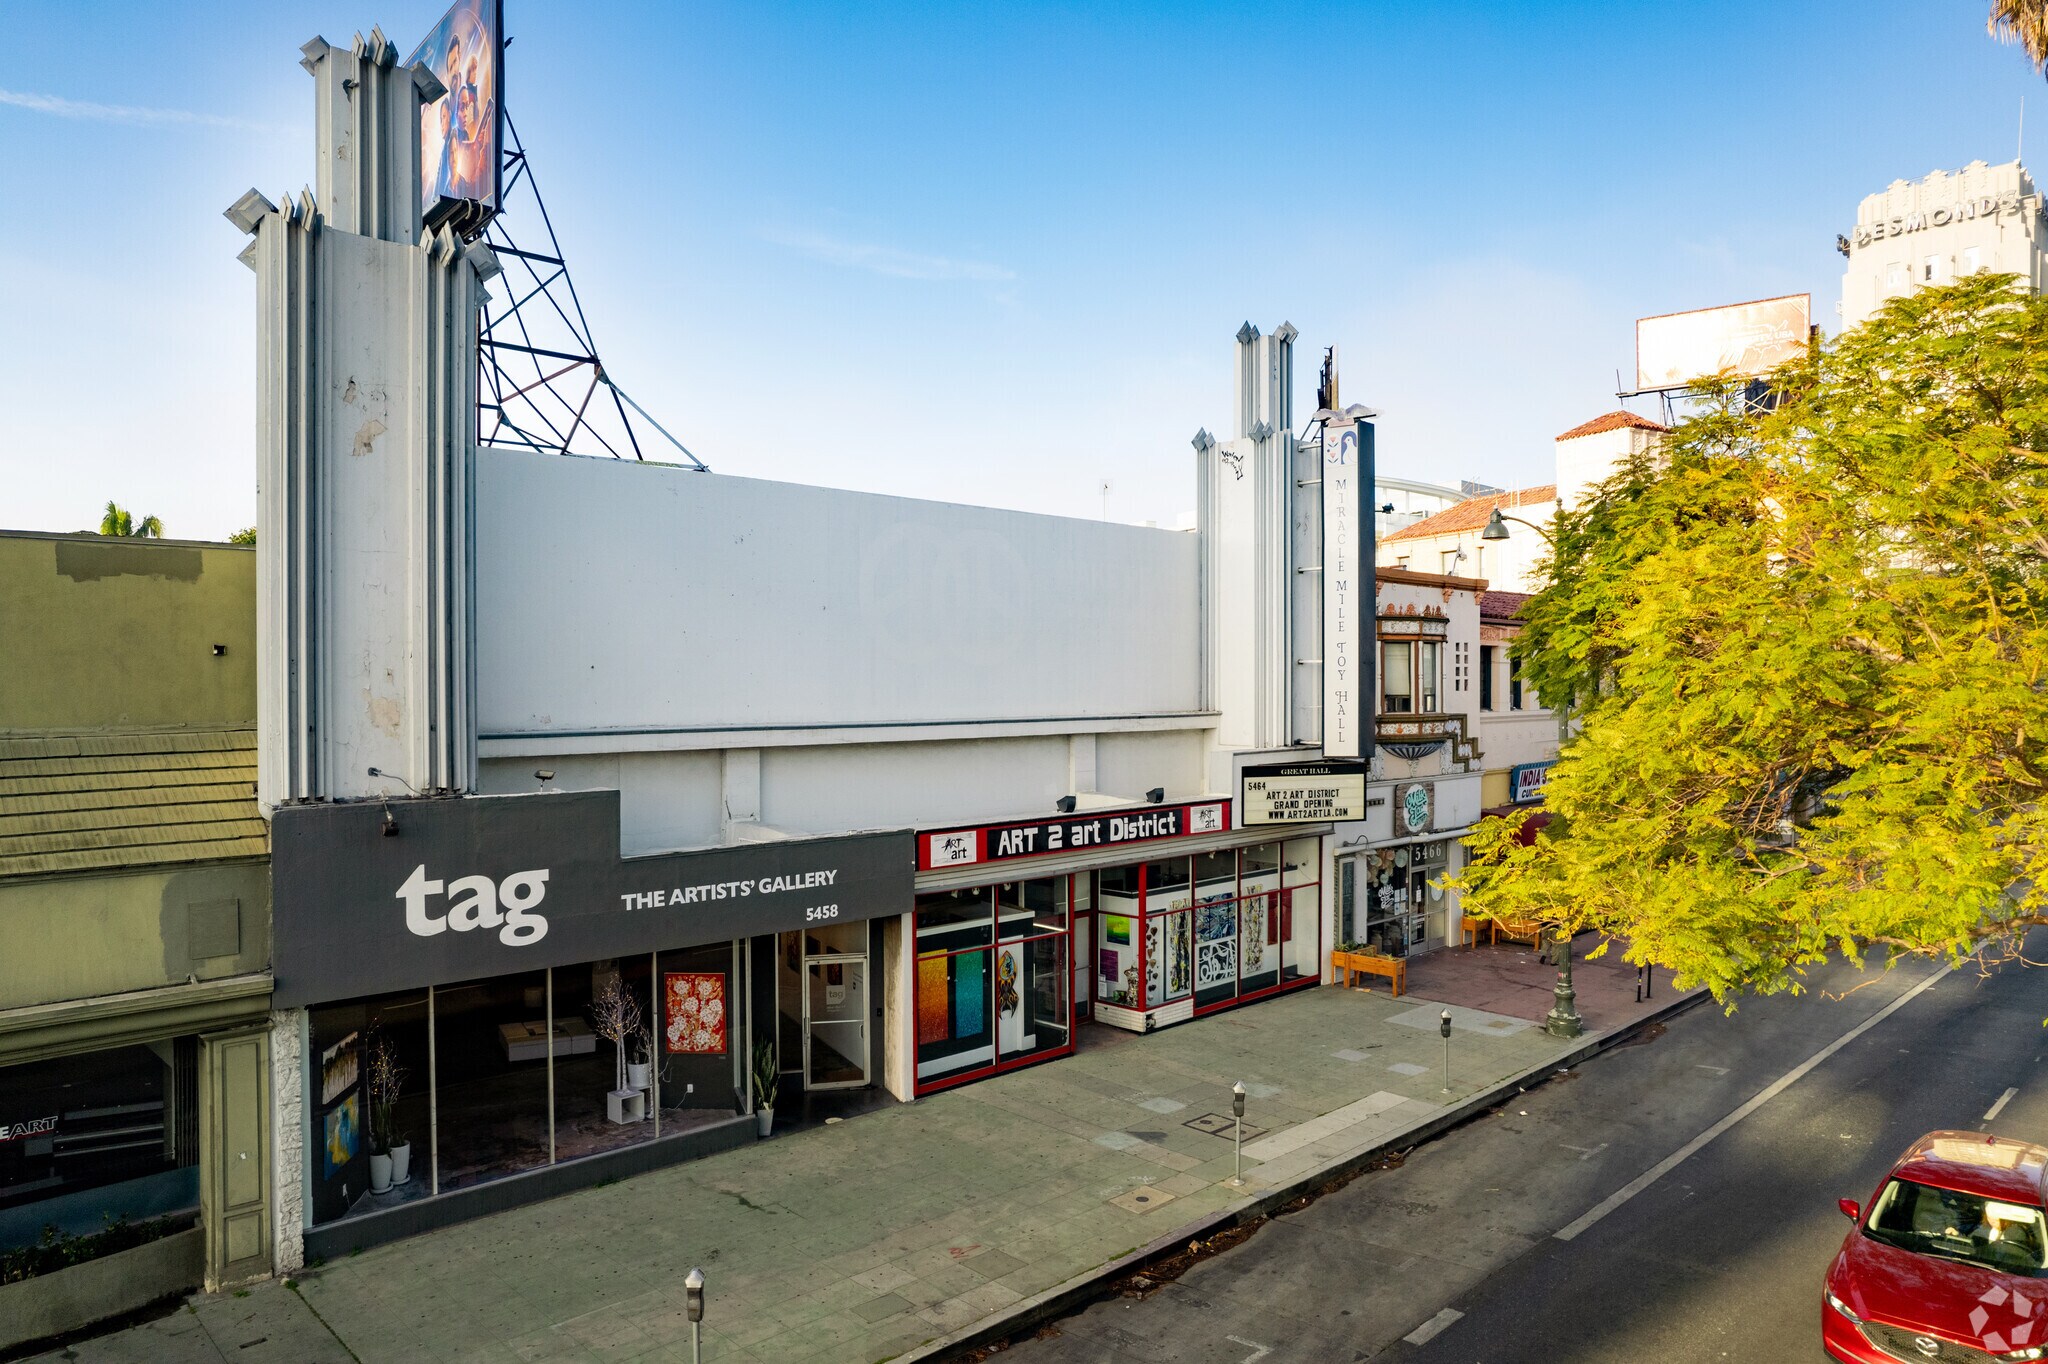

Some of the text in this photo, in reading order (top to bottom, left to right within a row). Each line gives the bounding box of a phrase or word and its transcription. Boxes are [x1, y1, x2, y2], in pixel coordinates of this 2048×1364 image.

[1853, 189, 2018, 244] DESMOND'S
[1774, 330, 1795, 339] USA
[1335, 478, 1348, 743] MIRACLE MILE TOY HALL
[1519, 768, 1547, 787] INDIA'S
[1248, 782, 1266, 791] 5464
[1266, 788, 1340, 800] ART 2 ART DISTRICT
[1273, 799, 1334, 810] GRAND OPENING
[1205, 818, 1216, 828] art
[997, 812, 1176, 856] ART 2 art District
[941, 838, 965, 853] ART
[951, 847, 967, 860] art
[1415, 843, 1442, 861] 5466
[621, 869, 838, 911] THE ARTISTS' GALLERY
[395, 863, 550, 947] tag
[806, 904, 839, 921] 5458
[829, 990, 843, 999] tag
